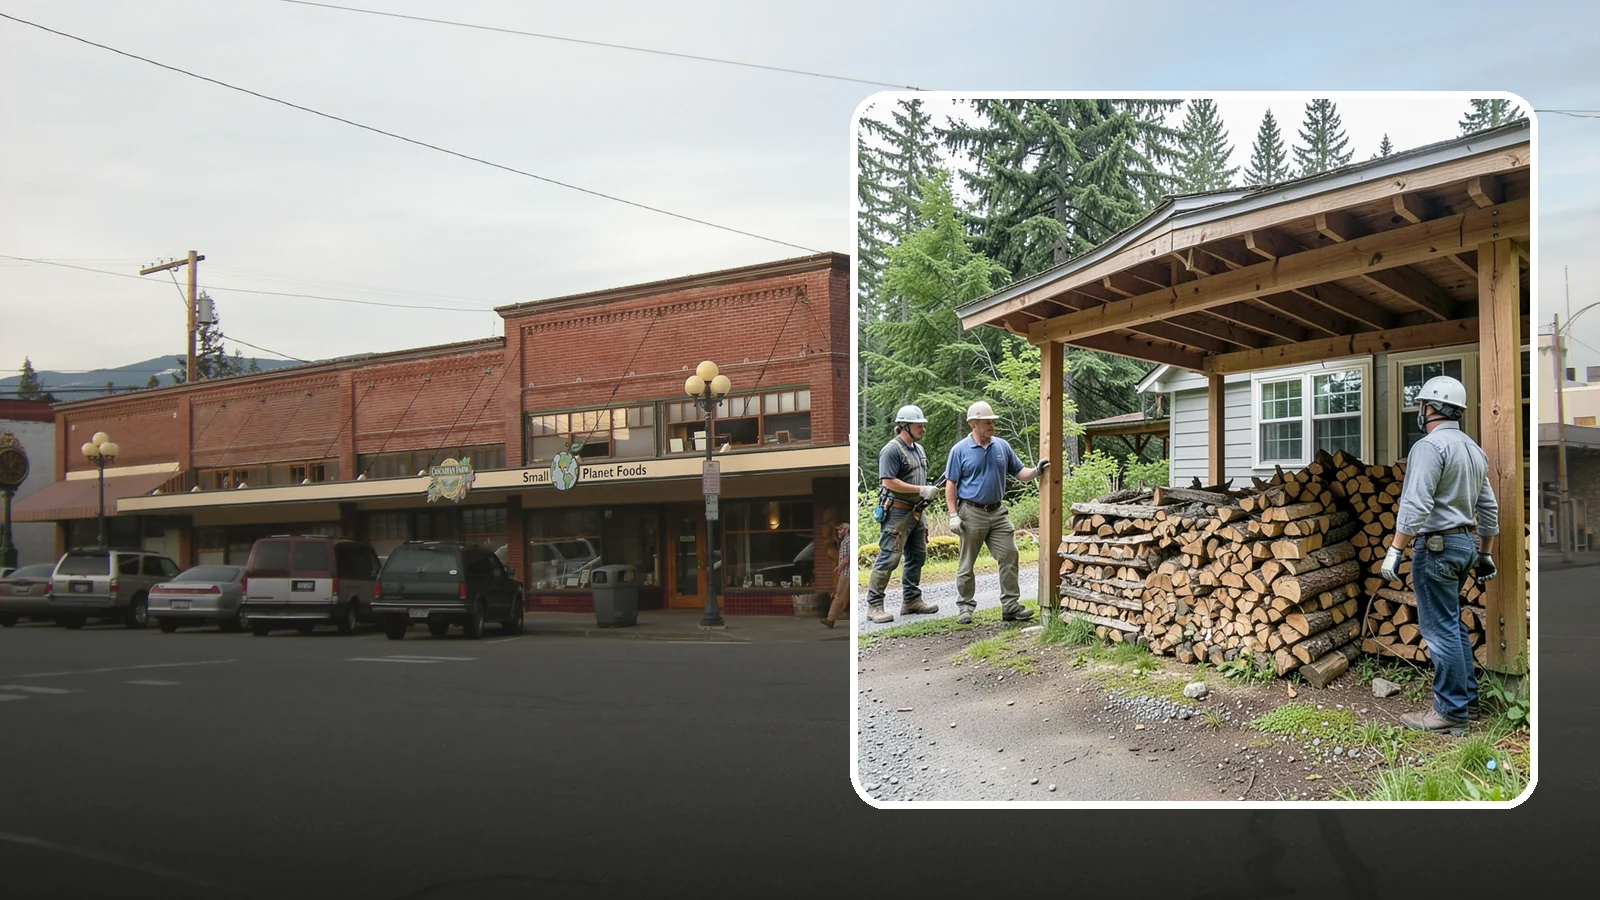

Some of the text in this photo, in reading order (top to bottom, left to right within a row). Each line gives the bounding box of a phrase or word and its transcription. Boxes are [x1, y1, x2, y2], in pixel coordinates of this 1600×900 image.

[432, 465, 469, 476] CASCADIAN FARM
[523, 464, 647, 483] Small Planet Foods
